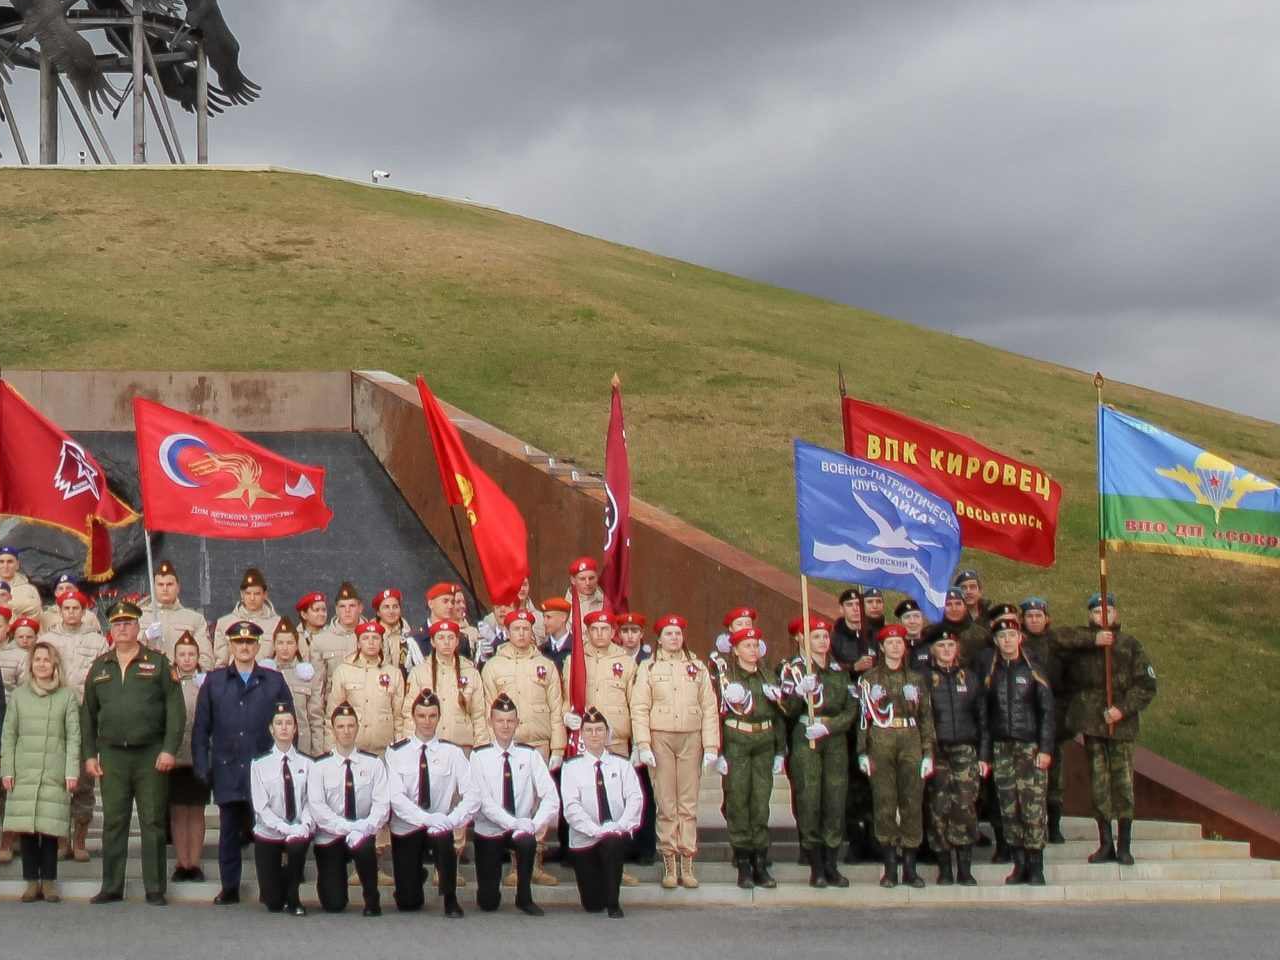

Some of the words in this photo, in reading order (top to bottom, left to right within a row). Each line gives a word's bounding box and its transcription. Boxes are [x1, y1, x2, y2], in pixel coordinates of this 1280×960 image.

[867, 433, 918, 465] ВПК
[930, 447, 1051, 501] КИРОВЕЦ
[851, 479, 878, 491] КЛУБ
[191, 505, 209, 516] Дом
[210, 510, 248, 521] детского
[956, 500, 1043, 530] Весьегонск
[1125, 520, 1167, 533] ВПО
[856, 553, 908, 568] ПЕНОВСКИЙ
